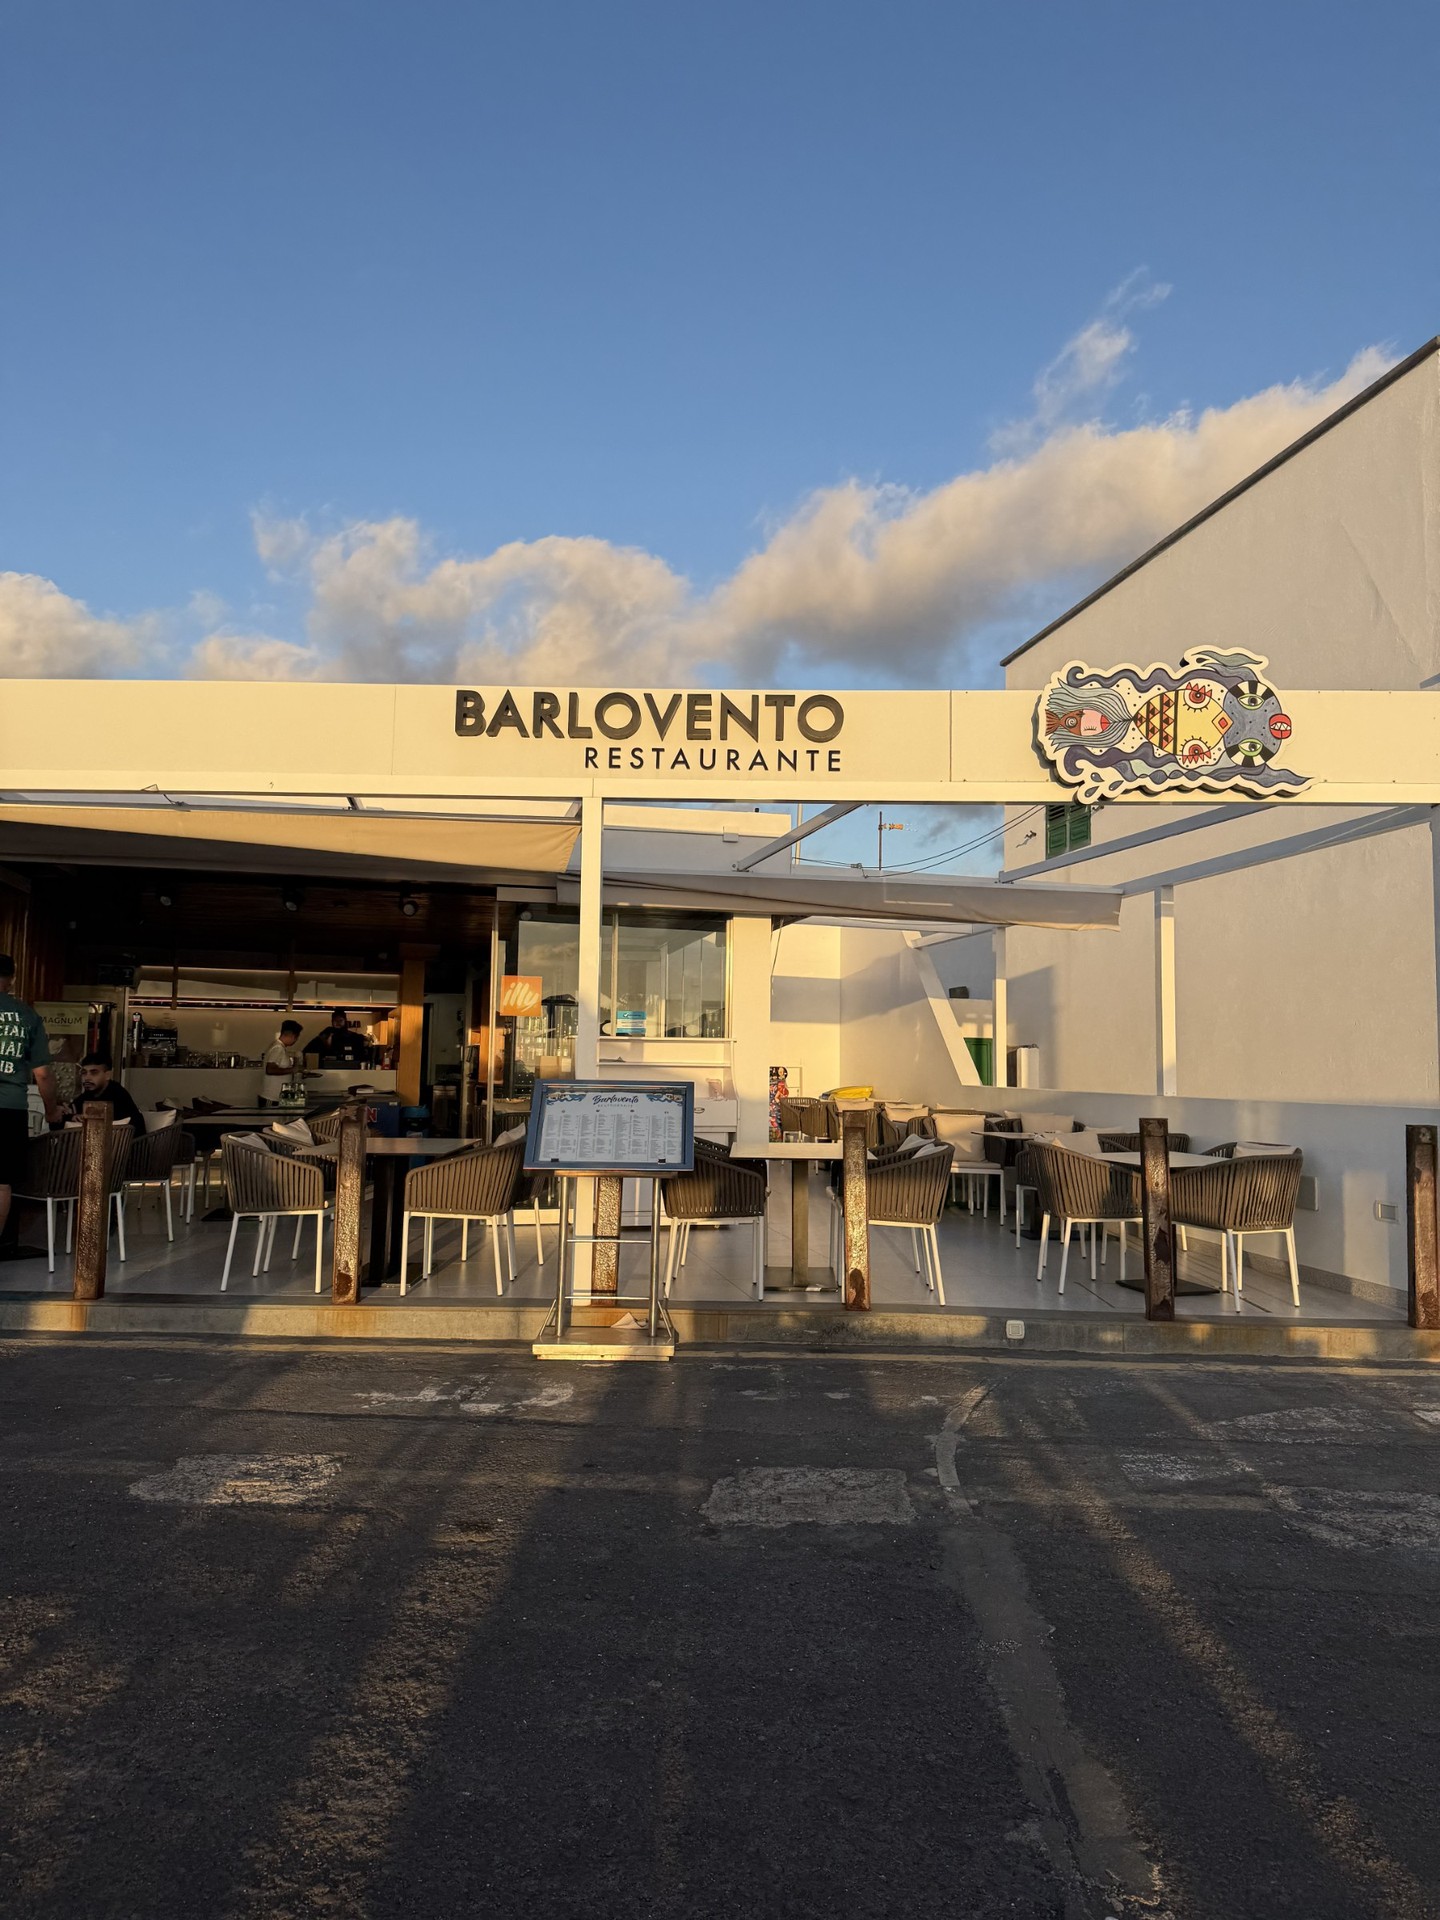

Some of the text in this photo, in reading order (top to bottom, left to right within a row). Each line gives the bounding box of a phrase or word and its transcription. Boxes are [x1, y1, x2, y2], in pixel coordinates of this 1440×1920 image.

[455, 689, 844, 743] BARLOVENTO
[585, 747, 841, 771] RESTAURANTE
[503, 982, 540, 1012] illy
[592, 1094, 639, 1105] Barlovento
